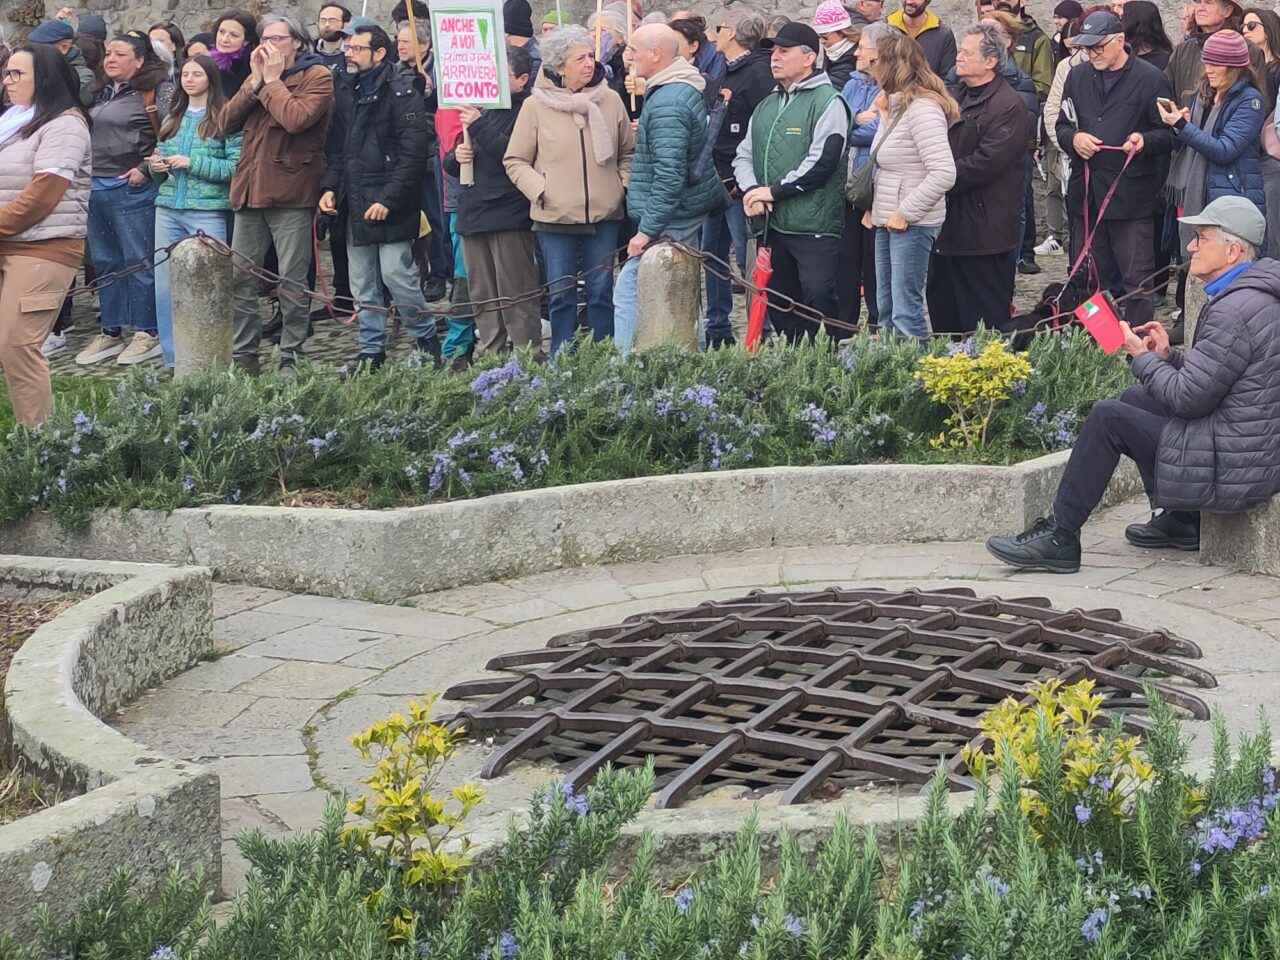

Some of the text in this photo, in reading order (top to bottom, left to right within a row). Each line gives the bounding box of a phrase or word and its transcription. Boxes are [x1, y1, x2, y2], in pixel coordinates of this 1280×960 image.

[439, 18, 475, 33] ANCHE
[451, 35, 475, 49] A VOI
[443, 82, 499, 99] IL CONTO
